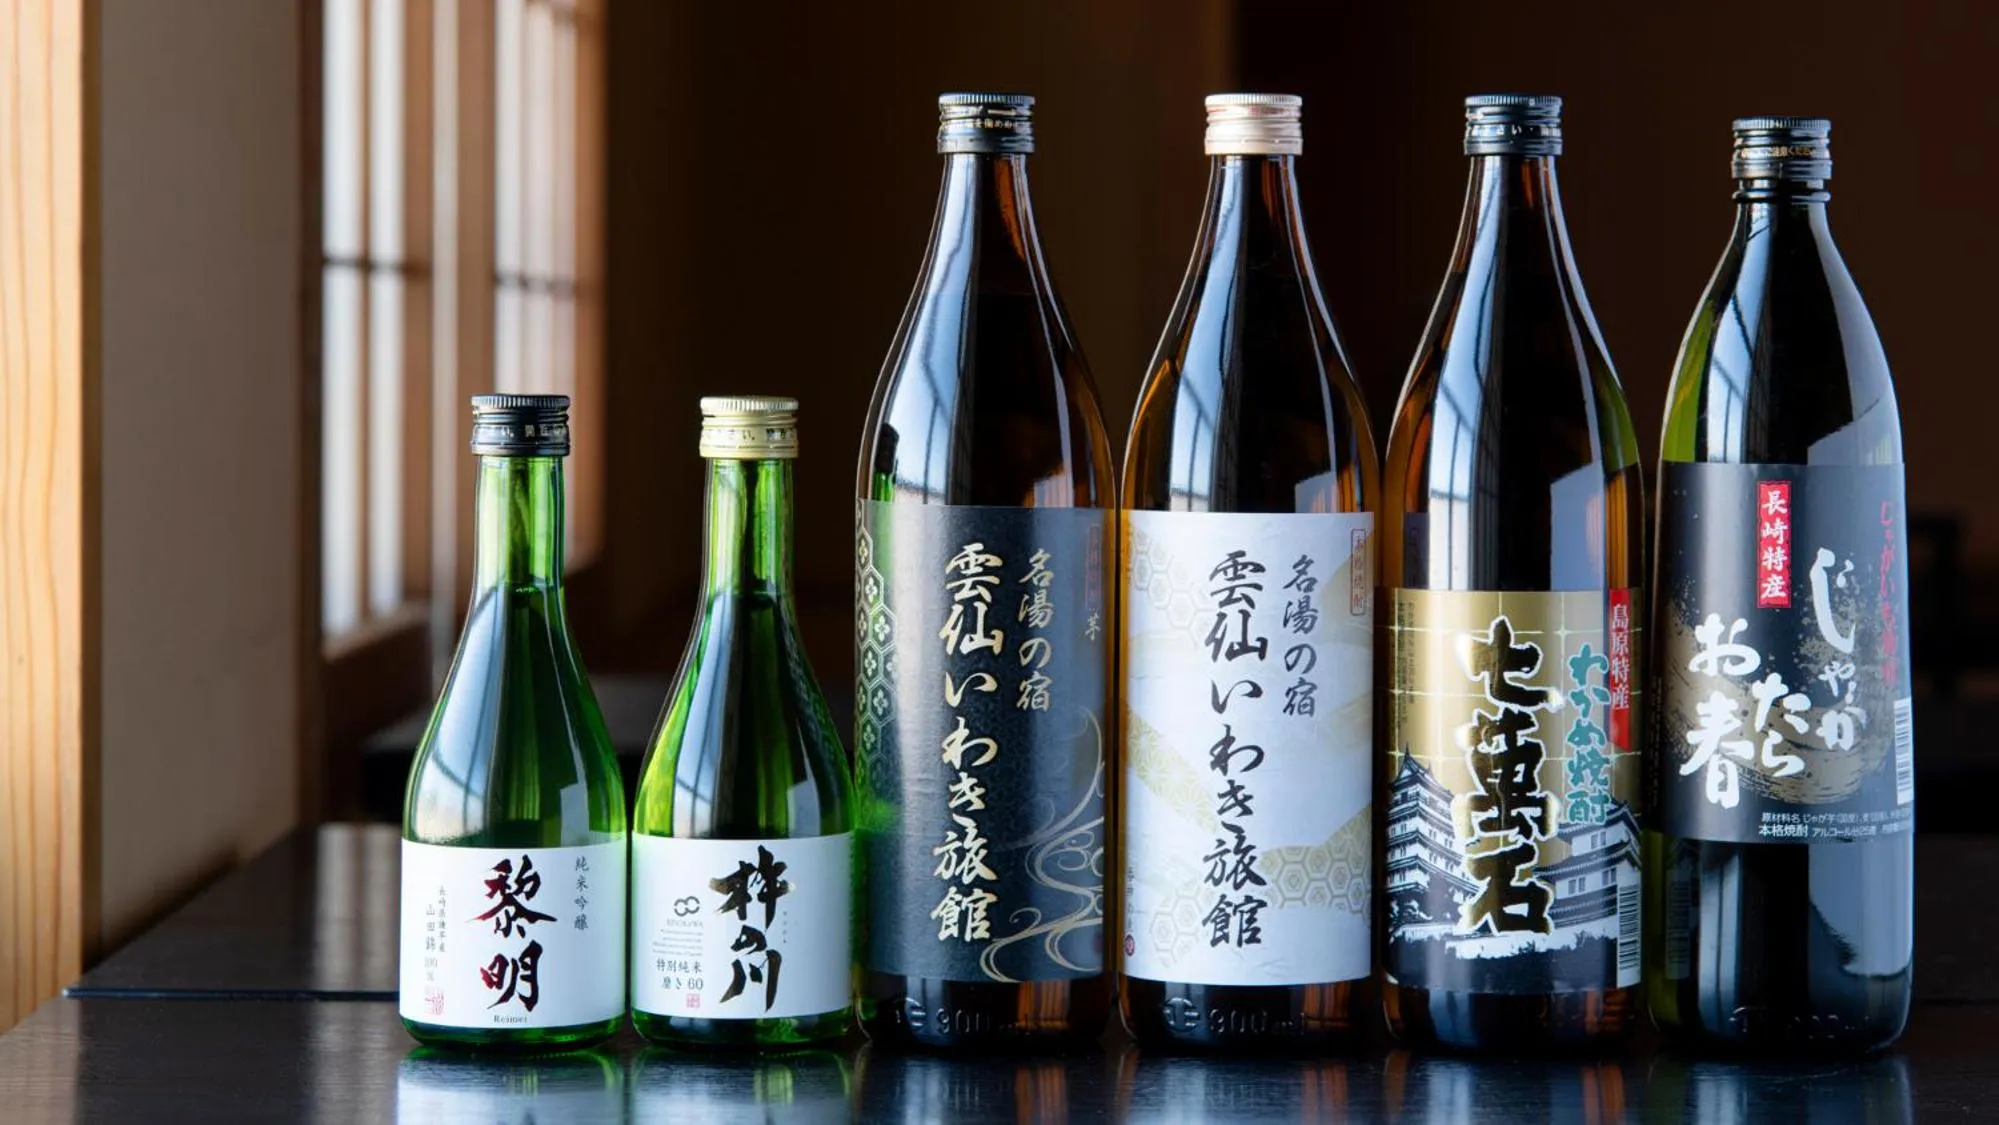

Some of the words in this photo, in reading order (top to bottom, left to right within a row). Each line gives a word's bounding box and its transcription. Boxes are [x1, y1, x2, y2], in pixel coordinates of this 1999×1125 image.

[1761, 490, 1788, 600] 長崎特産
[1017, 548, 1054, 712] 名湯の宿
[1283, 554, 1318, 718] 名湯の宿
[1612, 604, 1629, 710] 島原特産
[929, 542, 1003, 942] 雲仙いわき旅館
[1202, 550, 1268, 949] 雲仙いわき旅館
[1566, 642, 1611, 824] わかめ焼酎
[1679, 613, 1761, 809] お春
[1751, 672, 1812, 778] たら
[574, 856, 589, 931] 純米吟醸
[1759, 824, 1808, 838] 本格焼酎
[466, 854, 558, 1012] 黎明
[656, 958, 702, 973] 特別純米
[708, 844, 796, 1013] 杵の川
